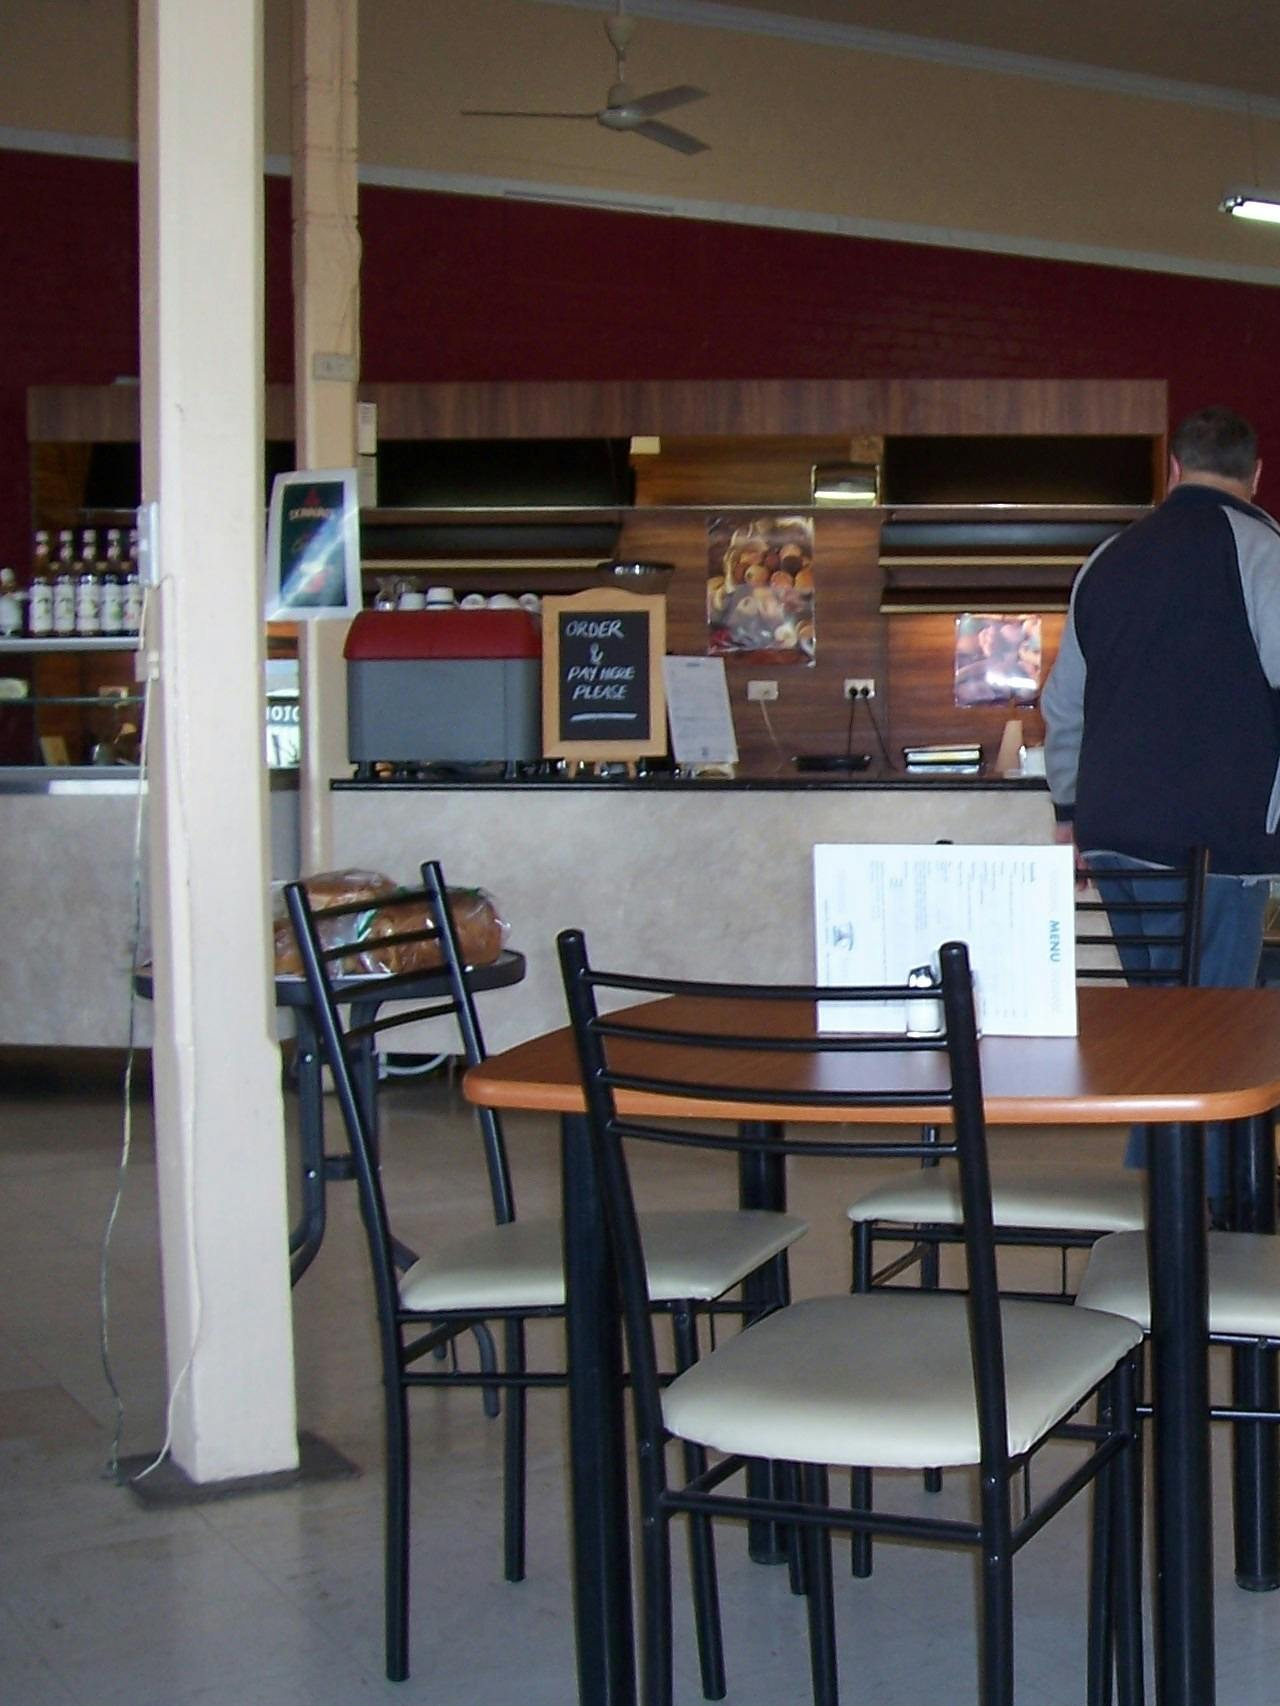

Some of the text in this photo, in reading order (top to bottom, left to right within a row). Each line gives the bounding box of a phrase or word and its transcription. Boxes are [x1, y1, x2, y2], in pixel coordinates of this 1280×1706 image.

[565, 619, 625, 638] ORDER
[567, 665, 636, 682] PAY HERE
[572, 684, 628, 701] PLEASE
[1049, 919, 1061, 963] MENU
